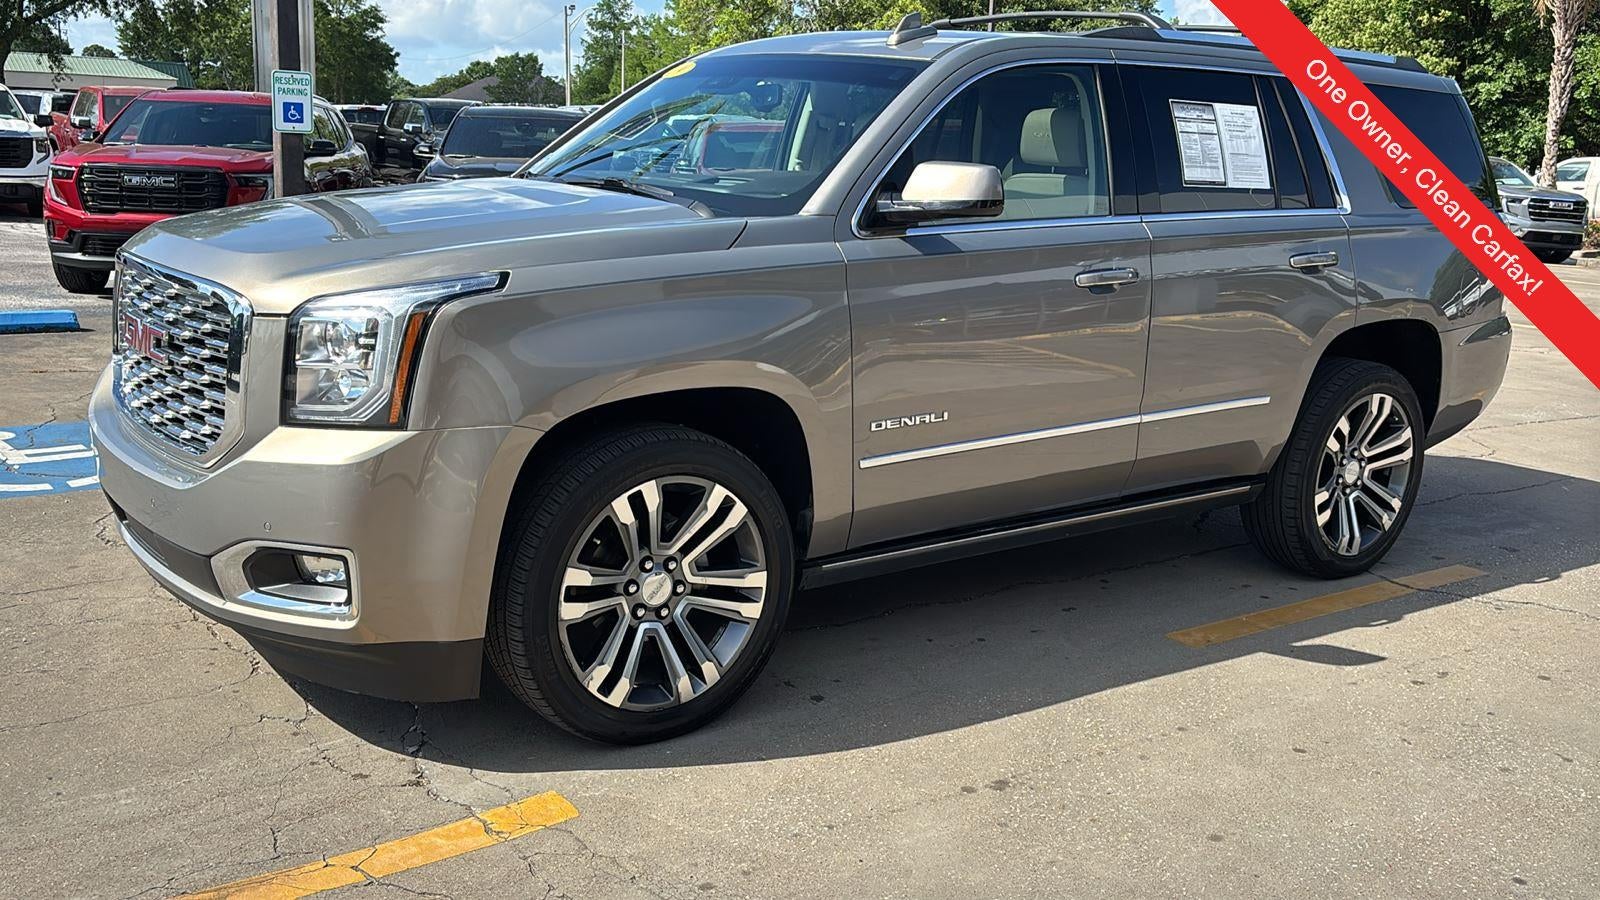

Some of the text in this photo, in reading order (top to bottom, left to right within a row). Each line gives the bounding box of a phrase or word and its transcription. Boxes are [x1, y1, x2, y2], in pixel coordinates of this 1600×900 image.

[274, 76, 310, 87] RESERVED
[277, 87, 308, 97] PARKING
[123, 175, 176, 187] GMC
[870, 411, 949, 432] DENALI
